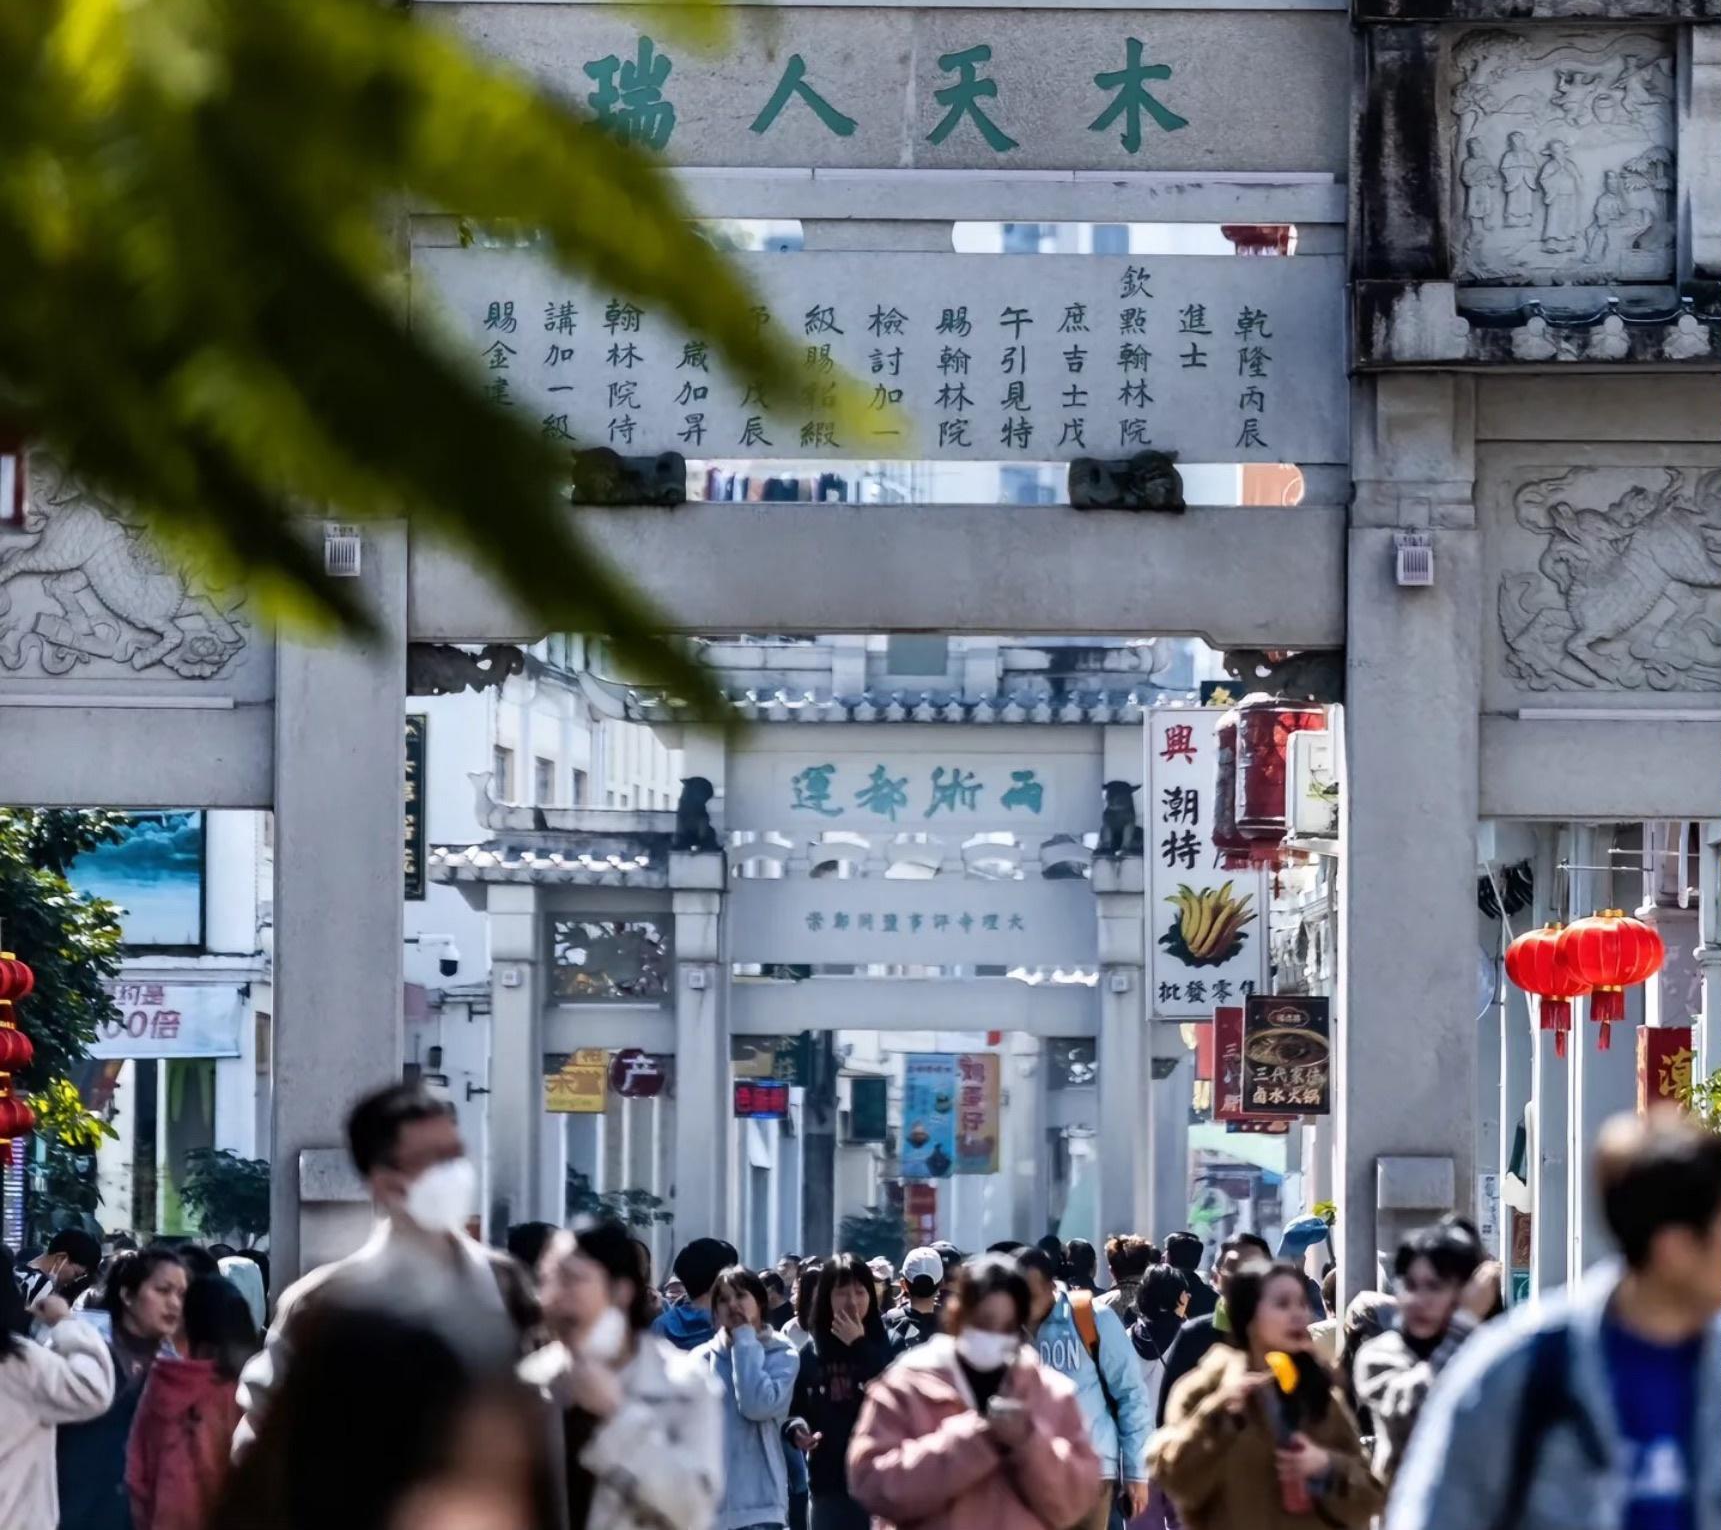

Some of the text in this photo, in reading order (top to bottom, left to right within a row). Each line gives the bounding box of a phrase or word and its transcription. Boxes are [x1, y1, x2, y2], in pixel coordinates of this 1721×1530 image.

[602, 298, 646, 445] 翰林院侍
[738, 307, 774, 447] 予戊辰
[867, 304, 910, 436] 檢討加一
[933, 306, 974, 449] 賜翰林院
[999, 306, 1034, 450] 午引見特
[1056, 303, 1090, 450] 庶吉士戊
[1116, 264, 1154, 446] 欽點翰林院
[1177, 304, 1212, 370] 進士
[1233, 304, 1274, 449] 乾隆丙辰
